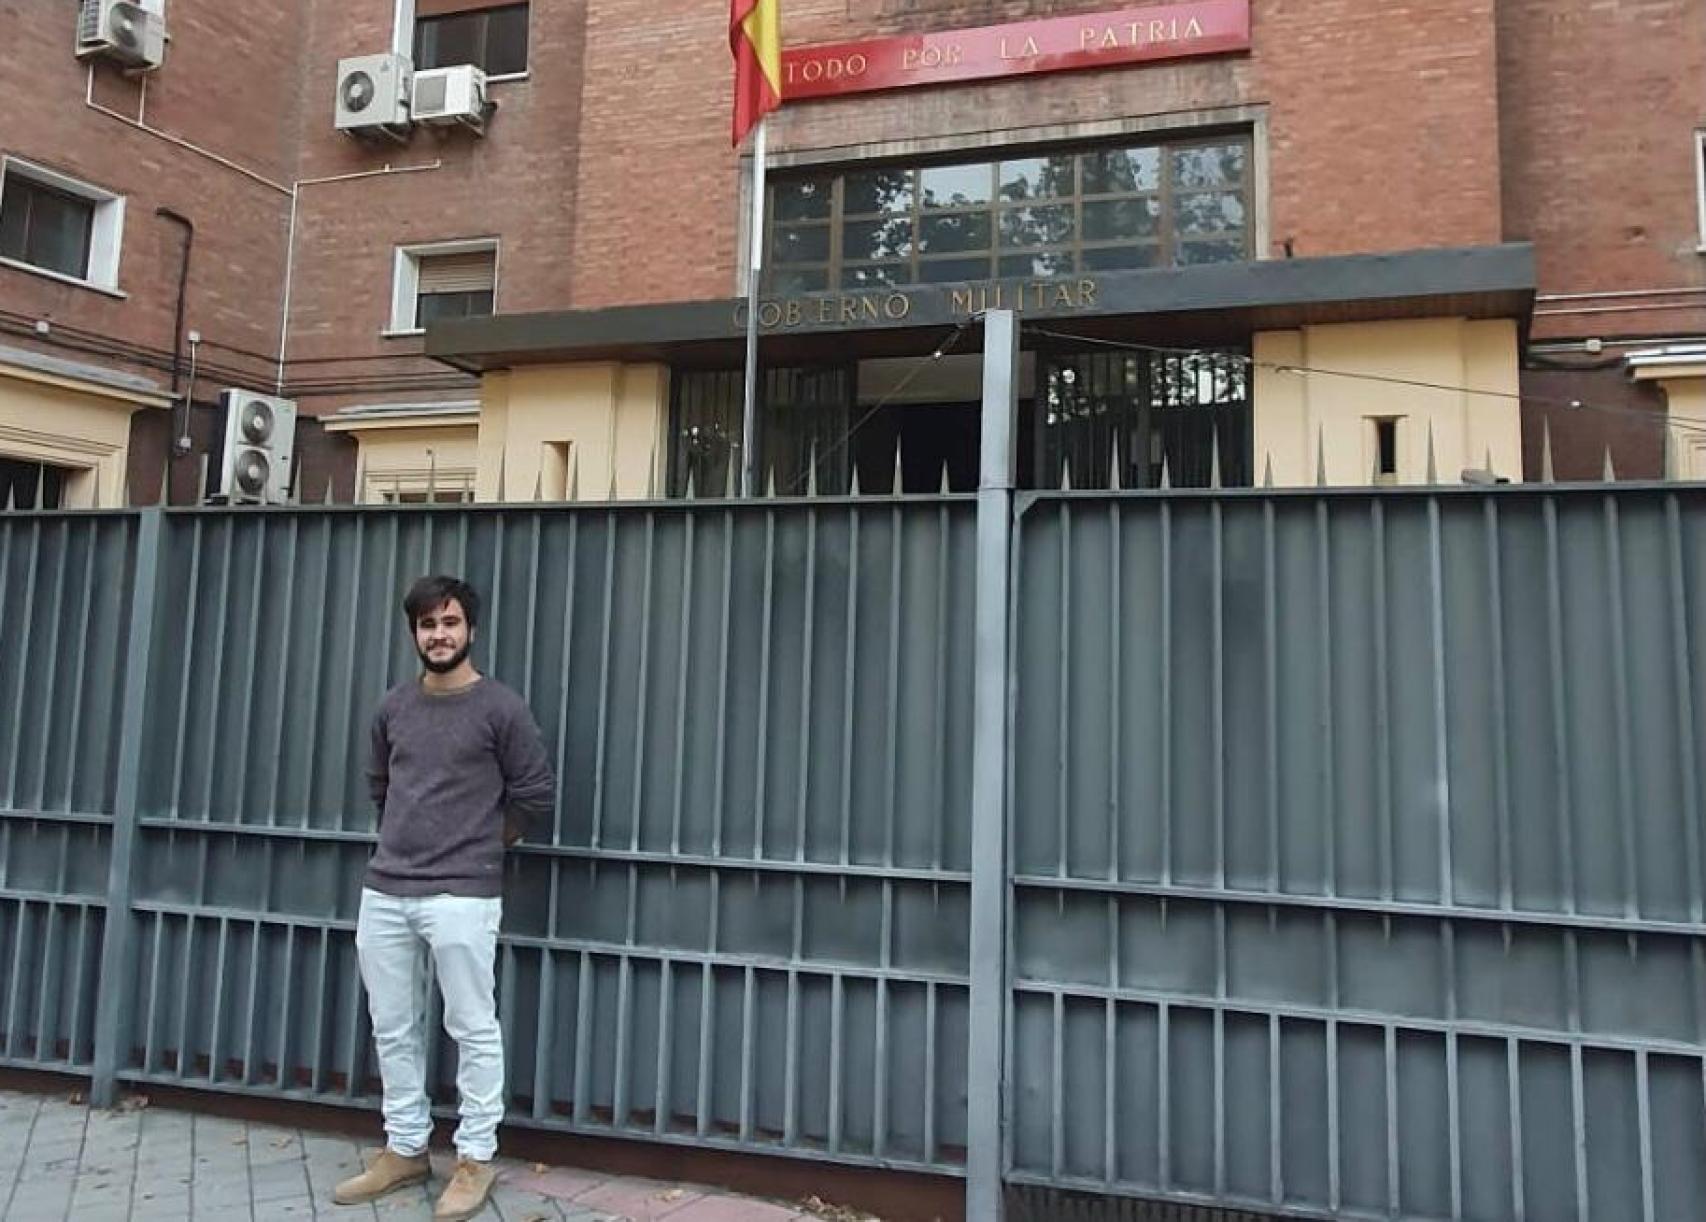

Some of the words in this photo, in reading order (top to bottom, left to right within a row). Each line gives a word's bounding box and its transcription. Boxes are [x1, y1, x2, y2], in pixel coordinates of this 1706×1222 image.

[786, 53, 867, 84] TODO
[902, 43, 964, 71] POR
[1000, 35, 1039, 59] LA
[1081, 16, 1203, 49] PATRIA
[733, 293, 910, 328] GOBERNO
[952, 279, 1096, 314] MILITAR
